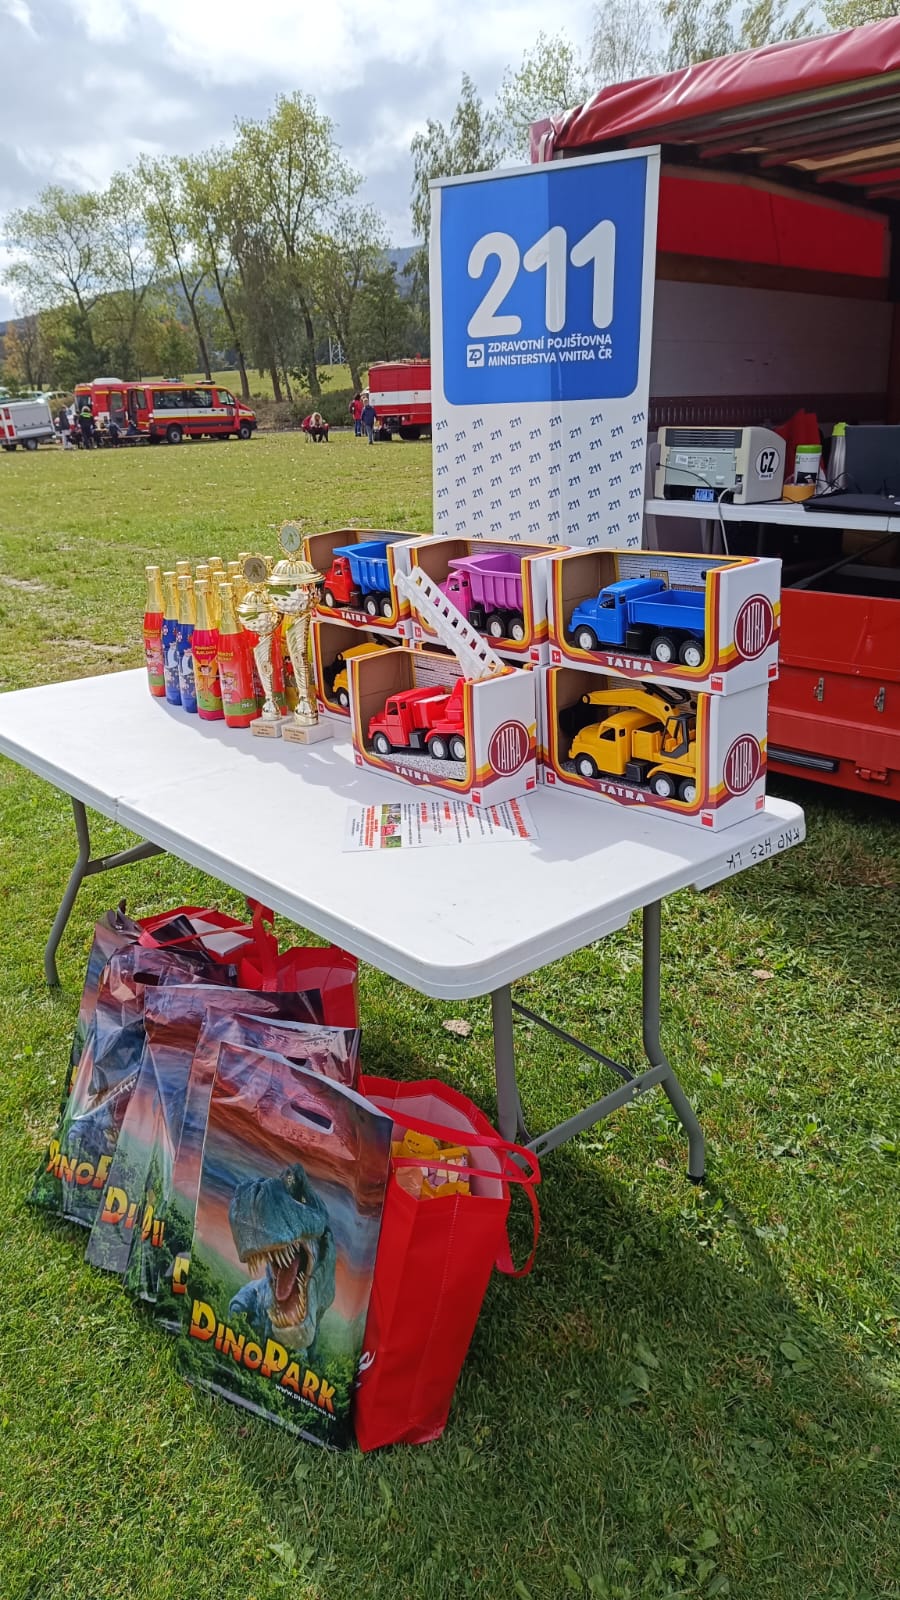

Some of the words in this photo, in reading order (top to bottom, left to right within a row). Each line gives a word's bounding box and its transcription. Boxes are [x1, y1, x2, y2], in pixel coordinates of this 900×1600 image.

[467, 219, 616, 339] 211
[488, 336, 544, 353] ZDRAVOTNÍ
[547, 333, 612, 348] POJIŠŤOVNA
[488, 352, 557, 367] MINISTERSTVA
[559, 350, 594, 363] VNITRA
[598, 346, 612, 359] ČR
[472, 418, 483, 429] 211
[509, 417, 521, 428] 211
[549, 416, 562, 427] 211
[590, 413, 603, 426] 211
[631, 412, 645, 424] 211
[436, 419, 448, 430] 211
[455, 430, 466, 442] 211
[490, 429, 502, 440] 211
[529, 428, 541, 440] 211
[569, 427, 582, 439] 211
[611, 425, 624, 438] 211
[436, 442, 448, 453] 211
[472, 442, 483, 452] 211
[509, 441, 521, 452] 211
[549, 440, 561, 451] 211
[589, 438, 602, 450] 211
[631, 438, 644, 449] 211
[455, 453, 466, 464] 211
[490, 453, 502, 464] 211
[529, 452, 541, 463] 211
[569, 451, 581, 463] 211
[610, 451, 622, 462] 211
[760, 451, 775, 473] CZ
[437, 465, 448, 475] 211
[472, 465, 483, 475] 211
[509, 464, 521, 475] 211
[548, 464, 561, 475] 211
[589, 463, 601, 474] 211
[630, 462, 642, 474] 211
[455, 476, 466, 487] 211
[490, 476, 502, 487] 211
[529, 476, 541, 486] 211
[568, 475, 581, 486] 211
[609, 475, 621, 487] 211
[437, 488, 448, 498] 211
[472, 488, 483, 498] 211
[509, 488, 521, 499] 211
[548, 488, 560, 498] 211
[588, 488, 600, 499] 211
[629, 487, 642, 499] 211
[455, 498, 466, 509] 211
[490, 499, 502, 509] 211
[528, 499, 540, 510] 211
[568, 499, 580, 510] 211
[608, 499, 621, 510] 211
[437, 509, 448, 519] 211
[472, 510, 483, 520] 211
[509, 510, 521, 521] 211
[548, 510, 560, 521] 211
[587, 512, 600, 522] 211
[628, 512, 640, 523] 211
[456, 521, 466, 531] 211
[490, 522, 502, 532] 211
[528, 522, 540, 533] 211
[567, 523, 579, 534] 211
[607, 523, 620, 535] 211
[547, 534, 560, 545] 211
[587, 534, 599, 546] 211
[627, 536, 639, 547] 211
[341, 611, 368, 623] TATRA
[741, 603, 766, 655] TATRA
[607, 656, 654, 673] TATRA
[495, 726, 523, 772] TATRA
[731, 742, 753, 789] TATRA
[394, 765, 431, 783] TATRA
[600, 783, 646, 803] TATRA
[190, 1299, 336, 1413] DINOPARK
